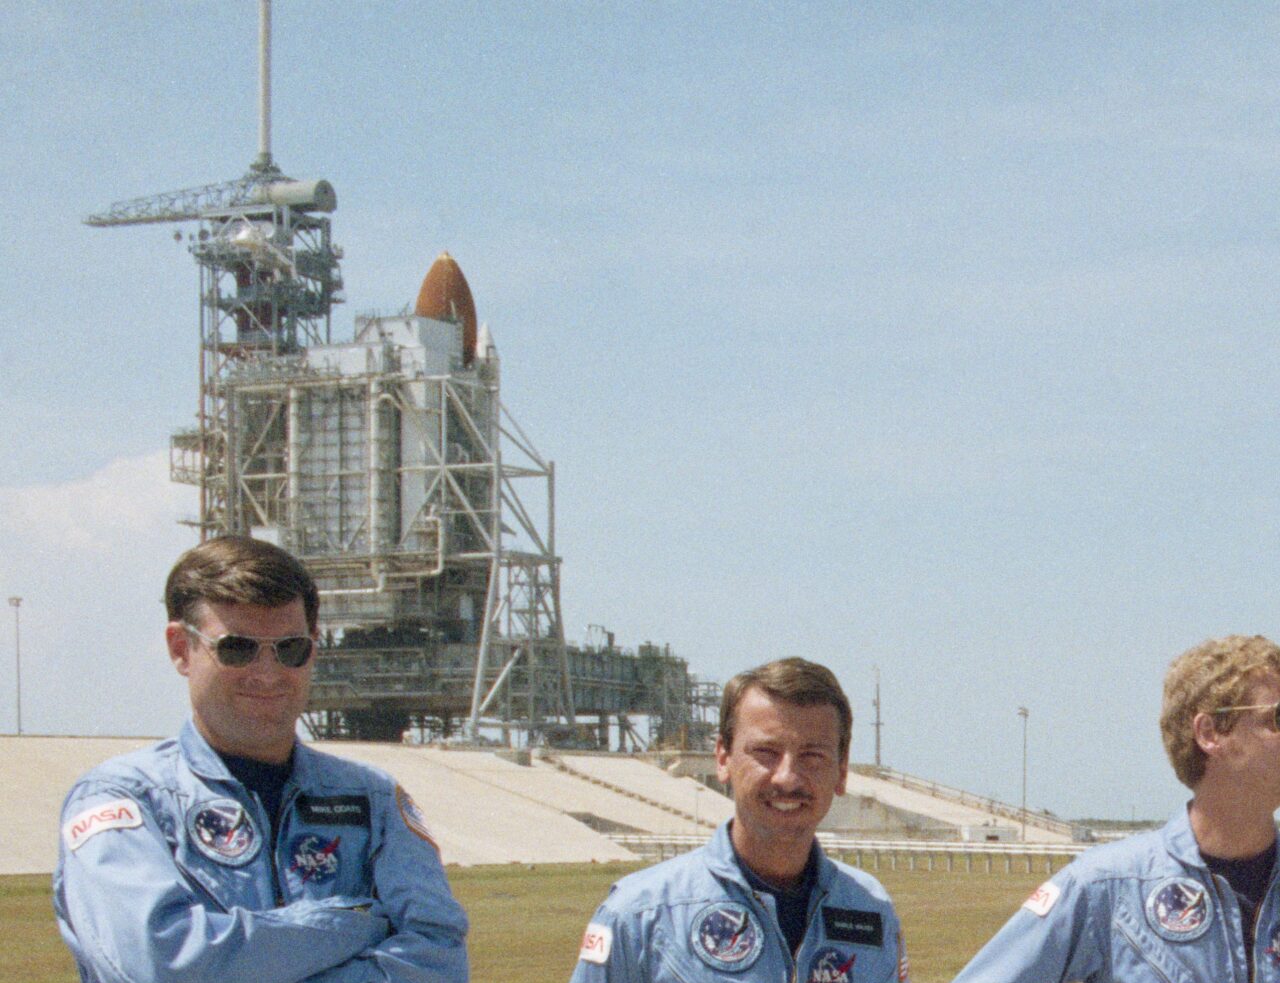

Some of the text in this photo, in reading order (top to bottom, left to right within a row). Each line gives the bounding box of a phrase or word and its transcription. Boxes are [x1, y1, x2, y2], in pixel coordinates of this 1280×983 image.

[71, 807, 134, 839] NASA
[294, 853, 339, 867] NASA
[812, 968, 849, 983] NASA
